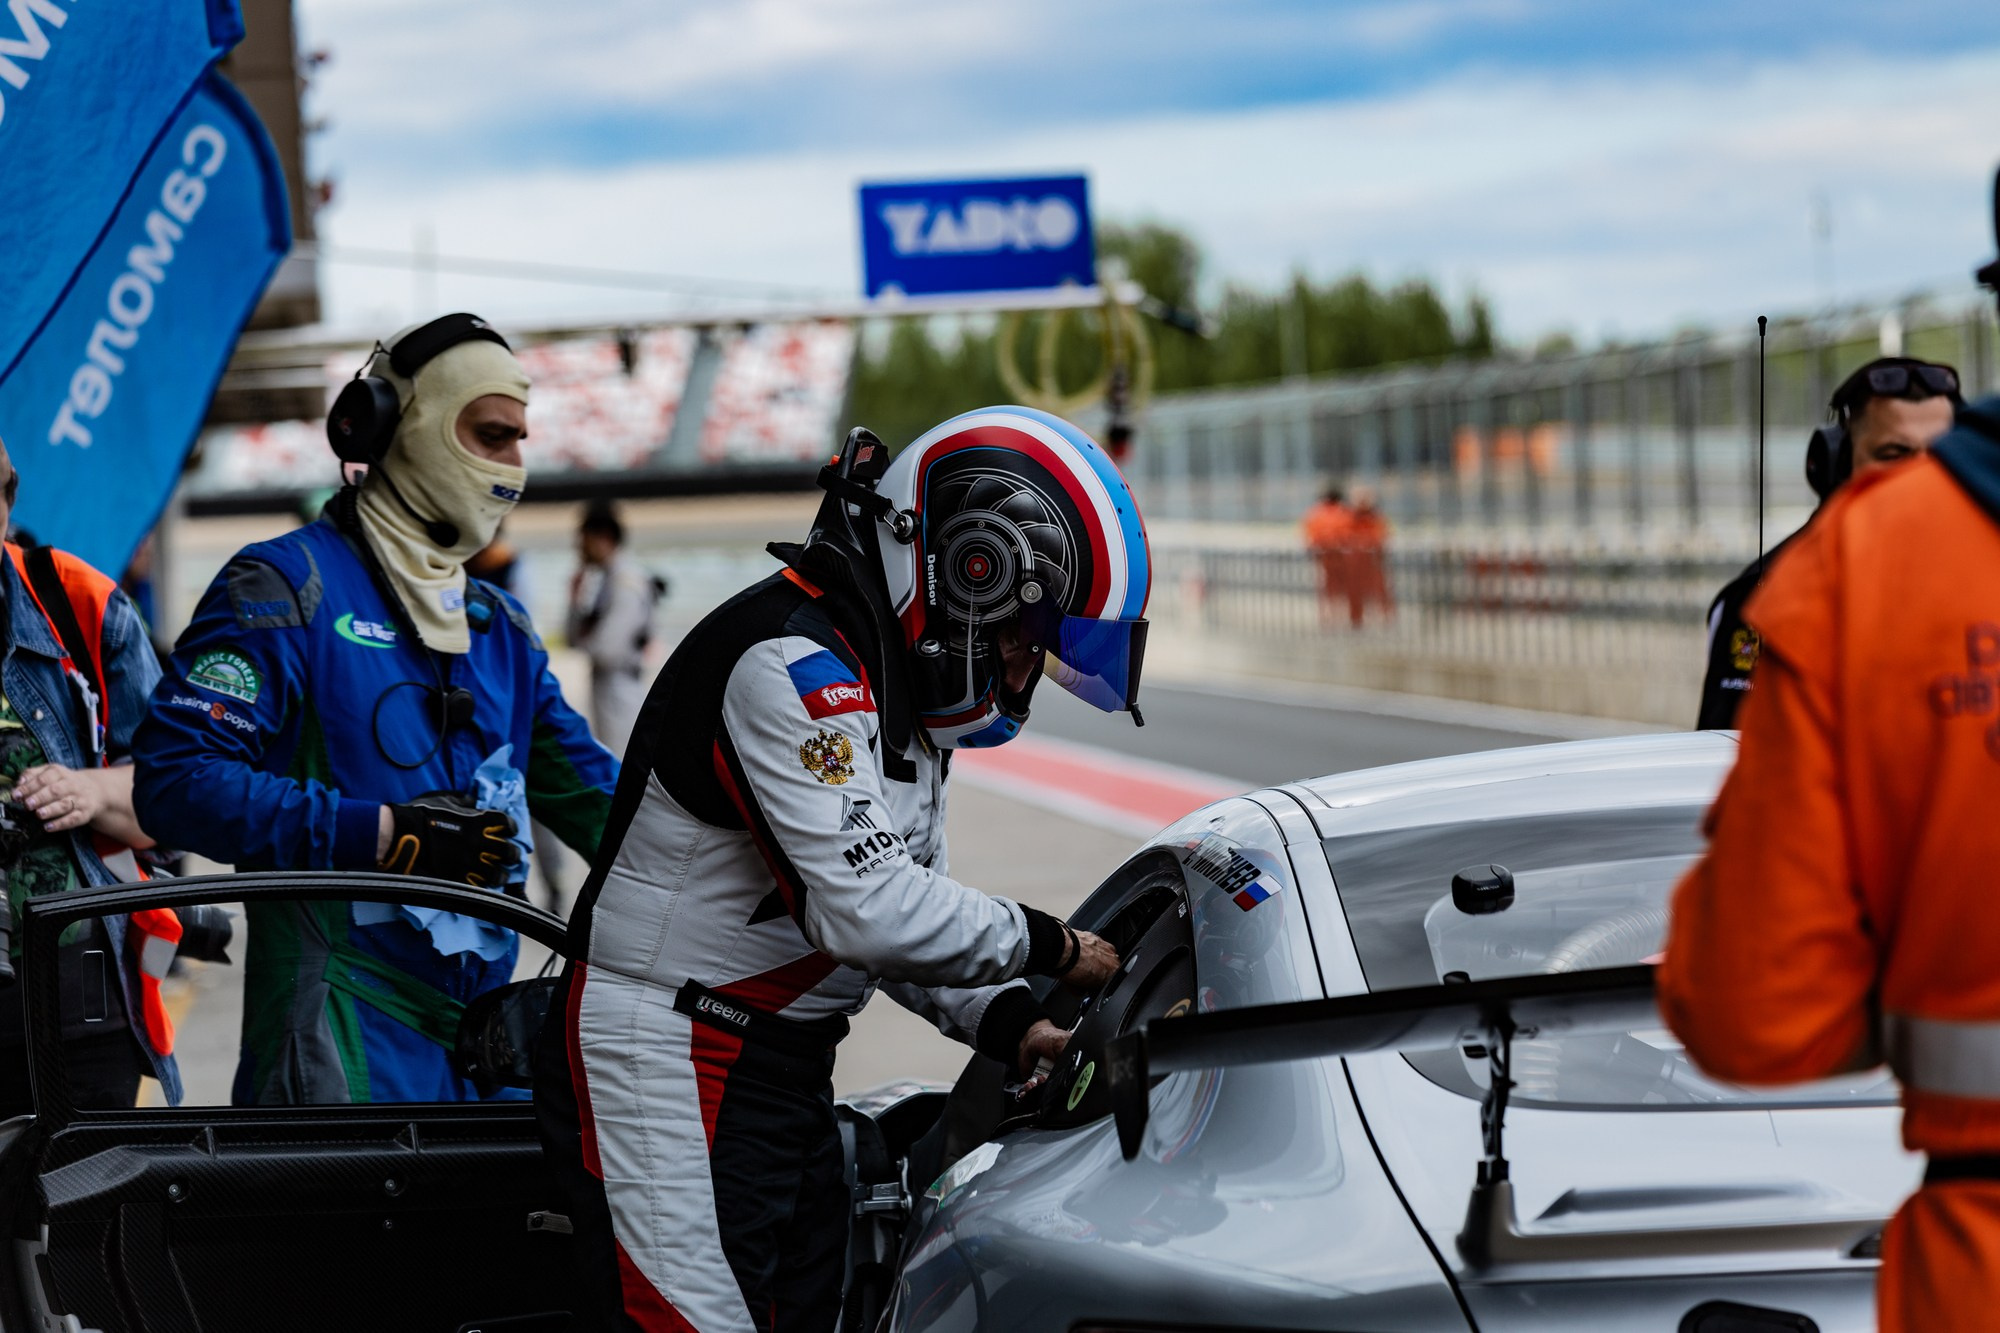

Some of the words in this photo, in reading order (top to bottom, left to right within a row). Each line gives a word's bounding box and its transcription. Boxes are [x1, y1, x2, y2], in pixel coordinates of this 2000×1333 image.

[928, 553, 937, 607] Denisov
[194, 652, 226, 674] MAGIC
[227, 653, 257, 690] FOREST
[695, 995, 751, 1027] freem
